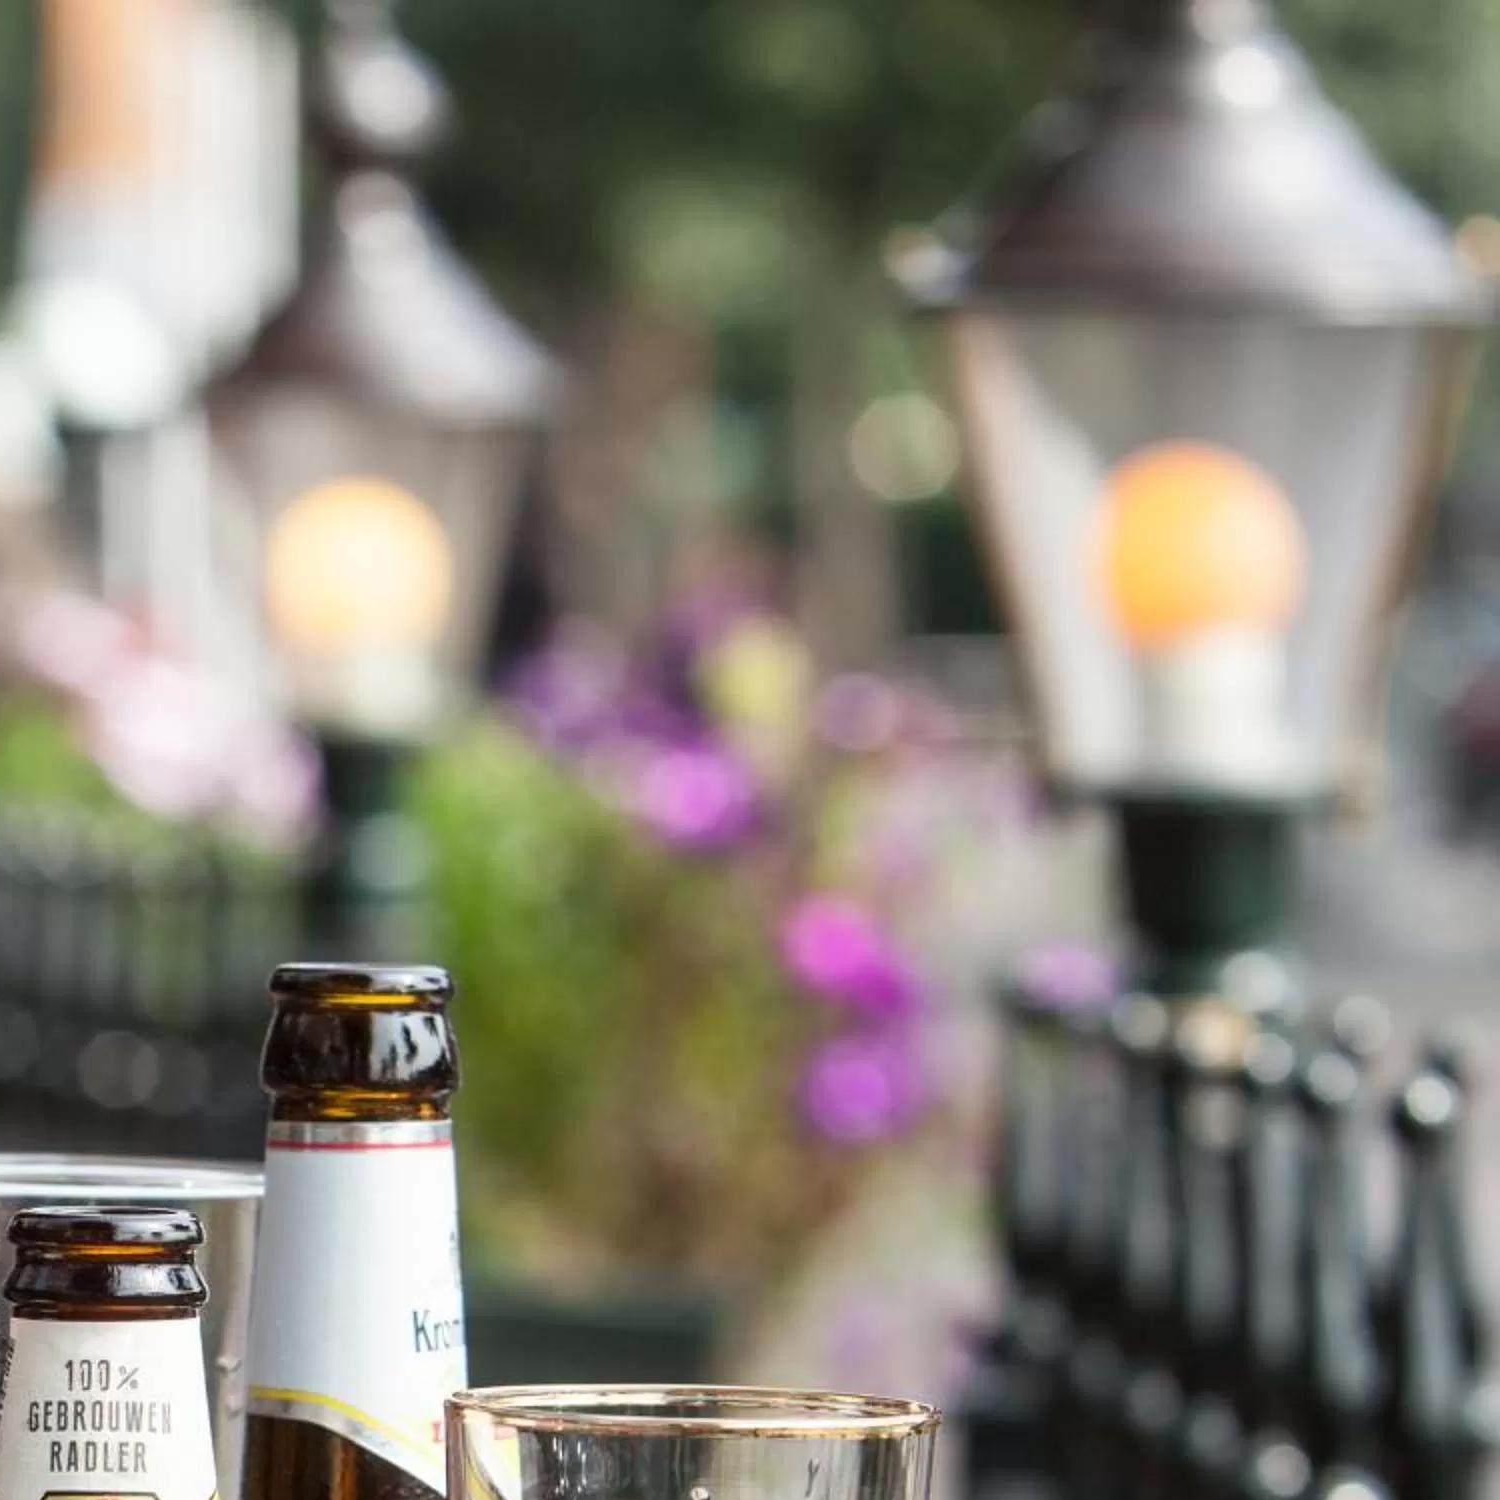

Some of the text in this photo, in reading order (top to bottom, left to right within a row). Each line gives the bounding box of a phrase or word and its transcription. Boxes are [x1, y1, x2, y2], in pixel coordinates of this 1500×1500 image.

[411, 1308, 461, 1353] Kro
[64, 1359, 140, 1392] 100%
[28, 1399, 173, 1434] GEBROUWEN
[49, 1440, 149, 1474] RADLER
